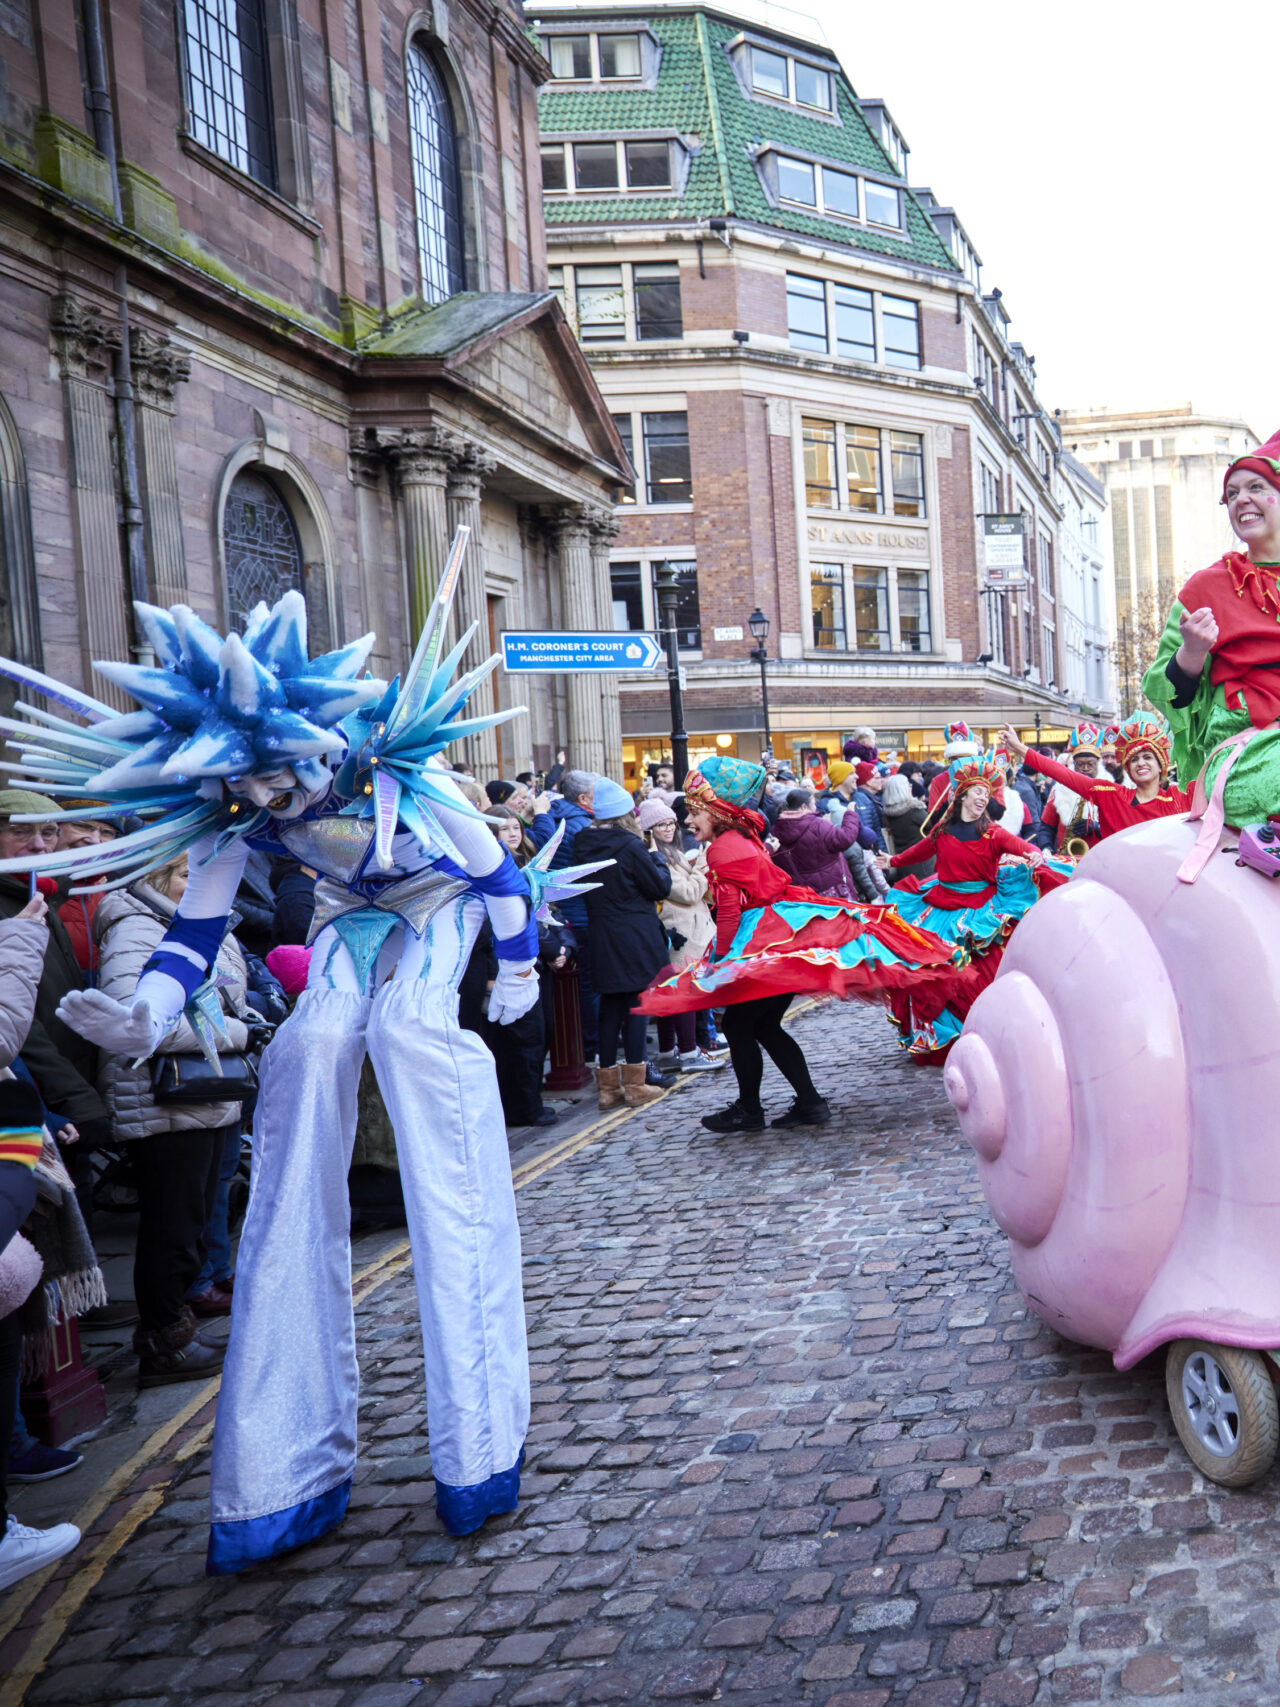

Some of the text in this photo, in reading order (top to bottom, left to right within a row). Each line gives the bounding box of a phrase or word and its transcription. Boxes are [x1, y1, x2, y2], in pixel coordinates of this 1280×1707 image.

[808, 526, 826, 541] ST
[878, 532, 926, 550] HOUSE
[507, 643, 624, 651] H.M. CORONER'S COURT
